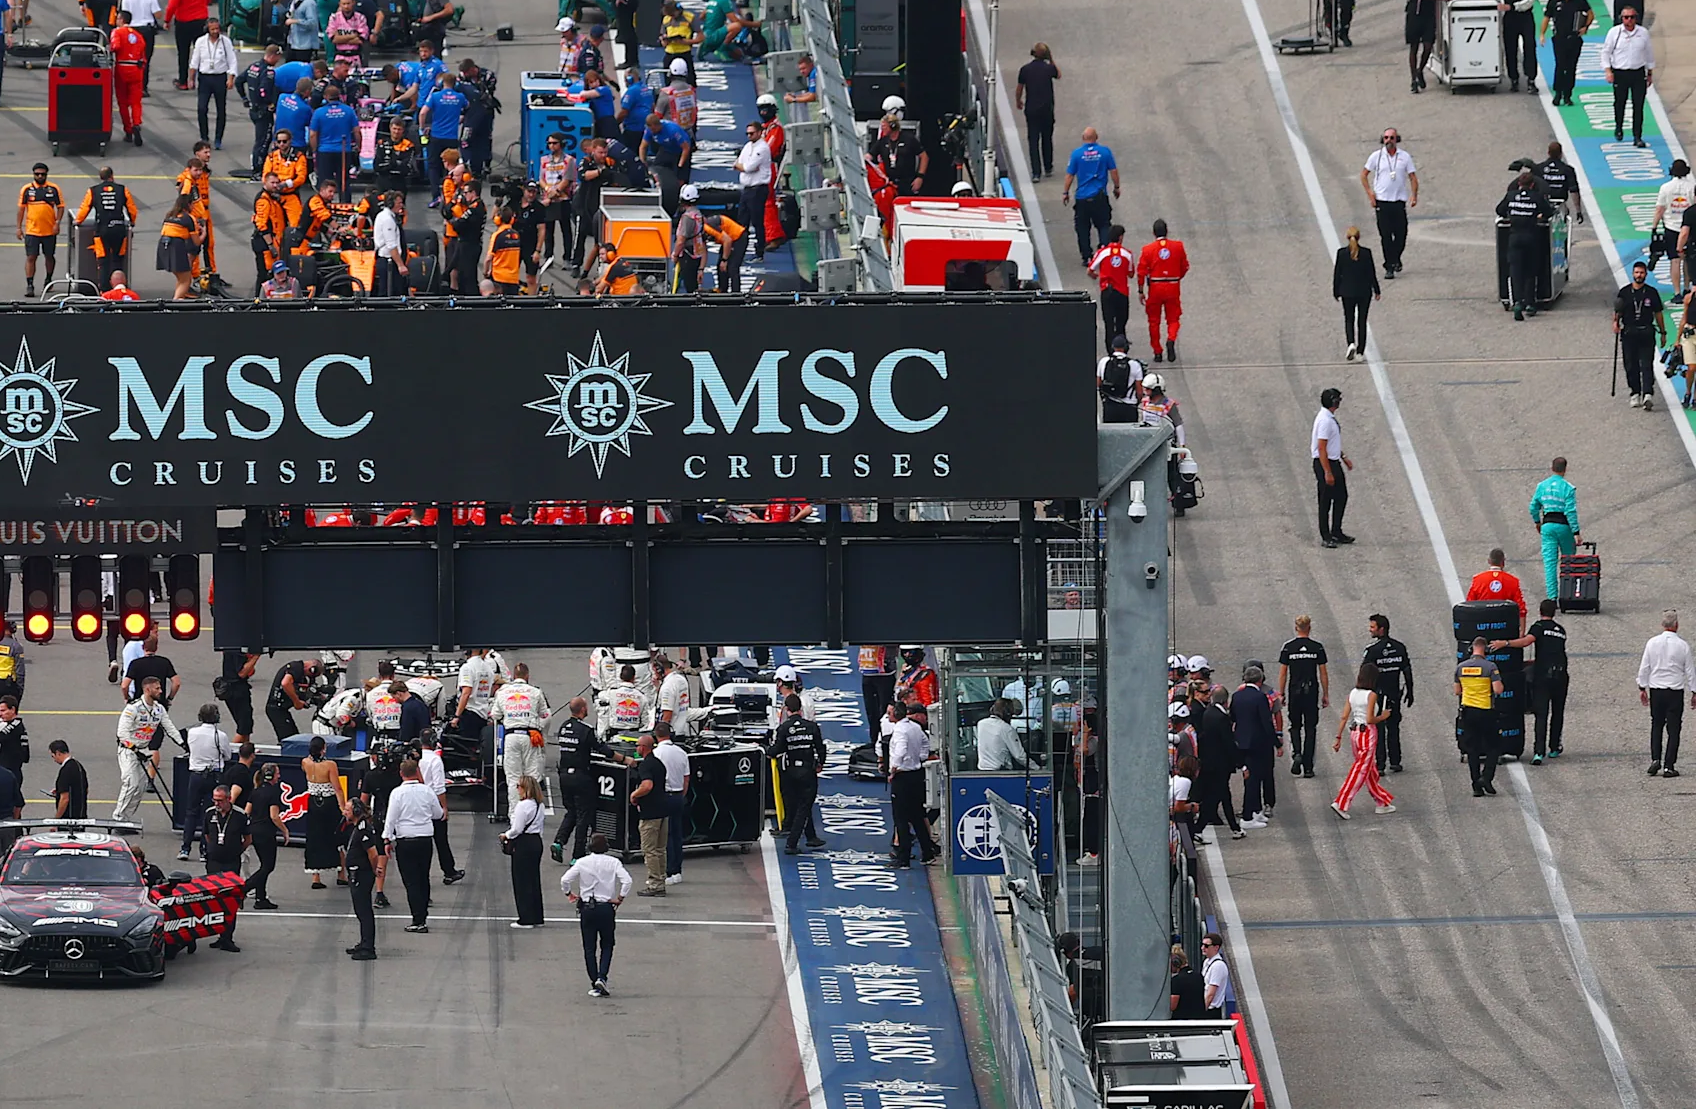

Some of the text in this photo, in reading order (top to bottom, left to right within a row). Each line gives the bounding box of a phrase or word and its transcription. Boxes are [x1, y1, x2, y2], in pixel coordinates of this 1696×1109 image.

[1463, 27, 1486, 43] 77
[1600, 141, 1665, 181] aramco
[108, 354, 373, 440] MSC
[682, 349, 948, 434] MSC
[110, 460, 375, 485] CRUISES
[684, 454, 949, 478] CRUISES
[54, 519, 183, 544] VUITTON
[1477, 622, 1507, 631] LEFT FRONT
[598, 776, 615, 796] 12
[822, 808, 888, 836] MSC
[68, 848, 110, 857] AMG
[796, 861, 820, 891] CRUISES
[830, 863, 900, 893] MSC
[59, 917, 119, 928] AMG
[174, 912, 225, 930] AMG
[808, 918, 832, 948] CRUISES
[842, 920, 913, 950] MSC
[819, 976, 843, 1006] CRUISES
[854, 978, 925, 1008] MSC
[831, 1034, 855, 1064] CRUISES
[865, 1036, 937, 1065] MSC
